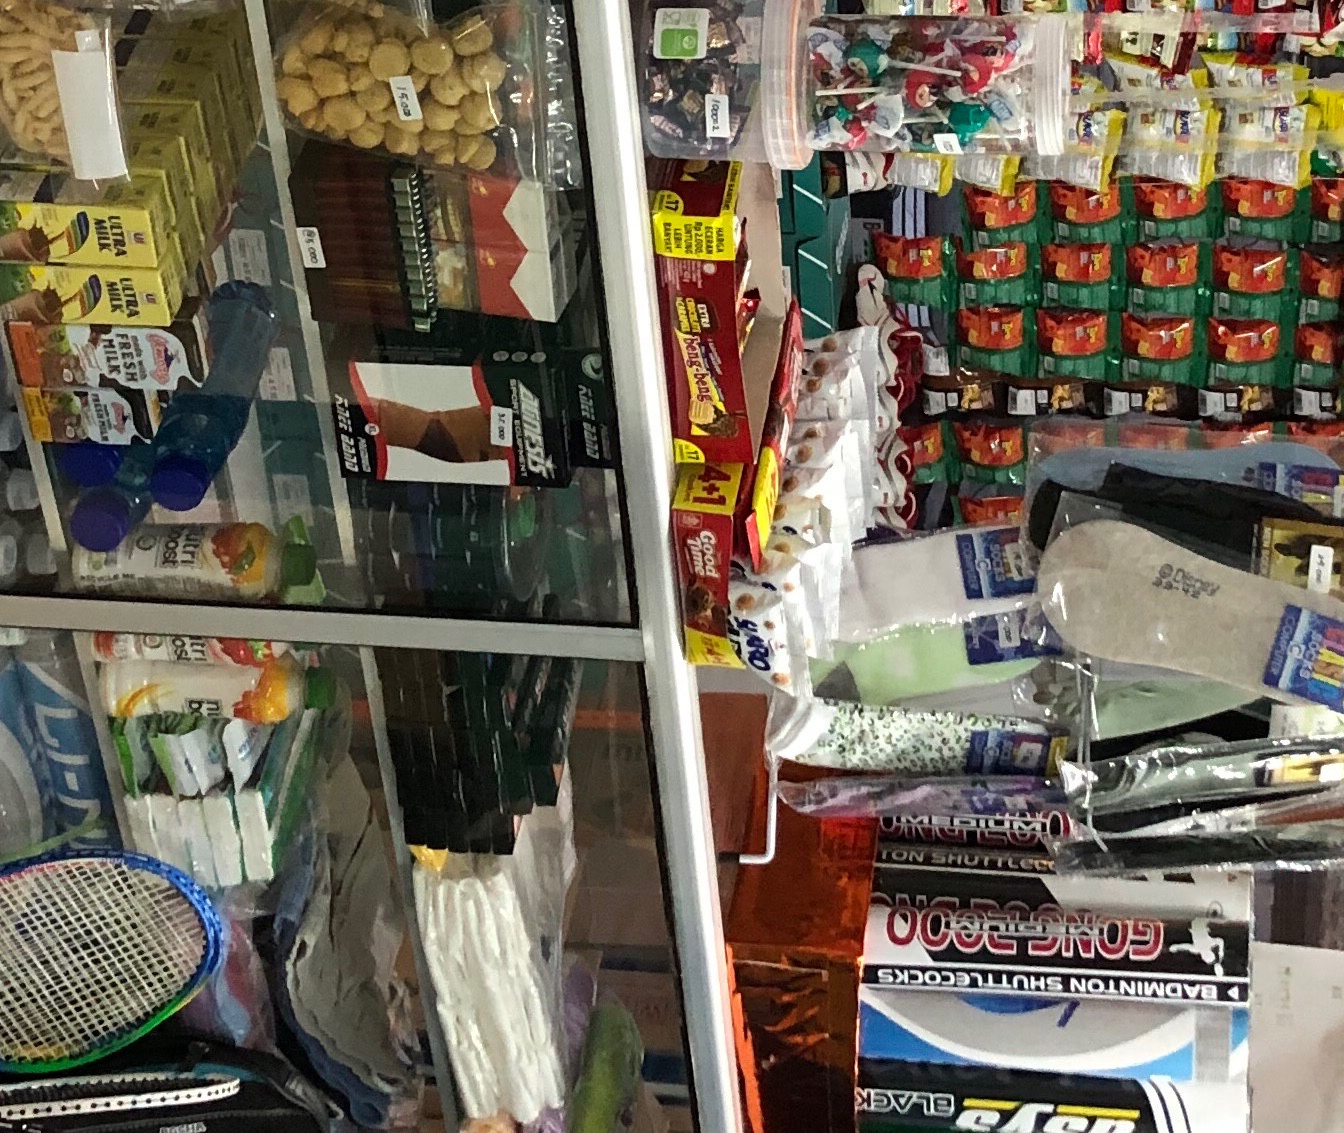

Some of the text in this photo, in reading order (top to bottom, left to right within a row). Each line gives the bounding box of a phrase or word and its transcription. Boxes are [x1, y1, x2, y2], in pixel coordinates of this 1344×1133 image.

[664, 199, 680, 212] 17
[93, 218, 112, 252] MILK
[107, 215, 129, 257] ULTRA
[105, 280, 125, 313] MILK
[118, 277, 141, 318] ULTRA
[697, 303, 710, 329] EXTRA
[101, 338, 121, 376] MILK
[115, 333, 138, 383] FRESH
[683, 336, 714, 403] beng-beng
[509, 378, 528, 478] SPORT EQUIPMENT
[517, 380, 557, 479] AGNESIS
[686, 450, 700, 461] 17
[692, 466, 731, 507] 4+1
[686, 538, 705, 577] Time
[699, 530, 719, 578] Good
[876, 968, 1218, 1000] BADMINTON SHUTTLECOCKS
[854, 1089, 956, 1117] BLACK
